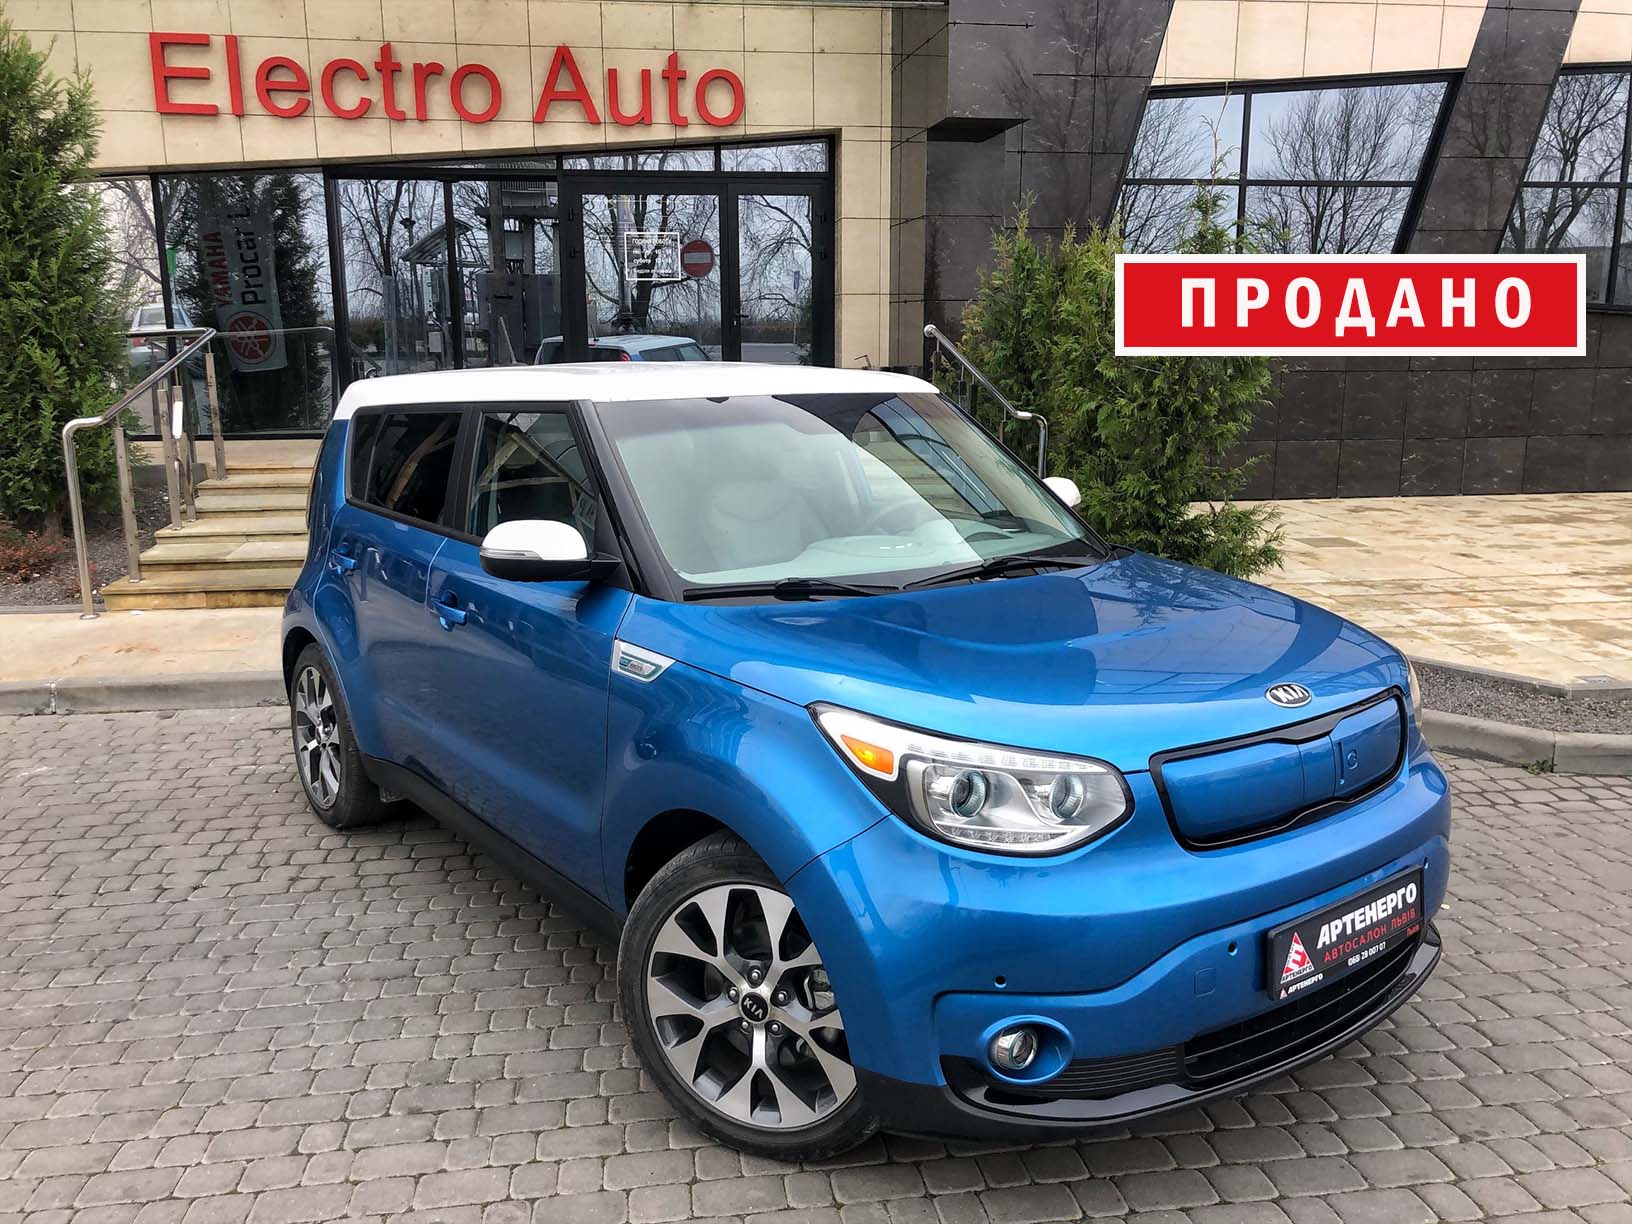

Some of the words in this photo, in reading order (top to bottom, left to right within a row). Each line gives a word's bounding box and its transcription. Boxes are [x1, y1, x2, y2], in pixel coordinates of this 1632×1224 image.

[149, 32, 502, 125] Electro
[533, 44, 746, 128] Auto
[202, 231, 234, 306] YAMAHA
[1271, 684, 1310, 703] KIA
[1316, 882, 1417, 949] АРТЕНЕРГО
[1324, 923, 1387, 963] АВТОСАЛОН
[743, 997, 764, 1019] KIA
